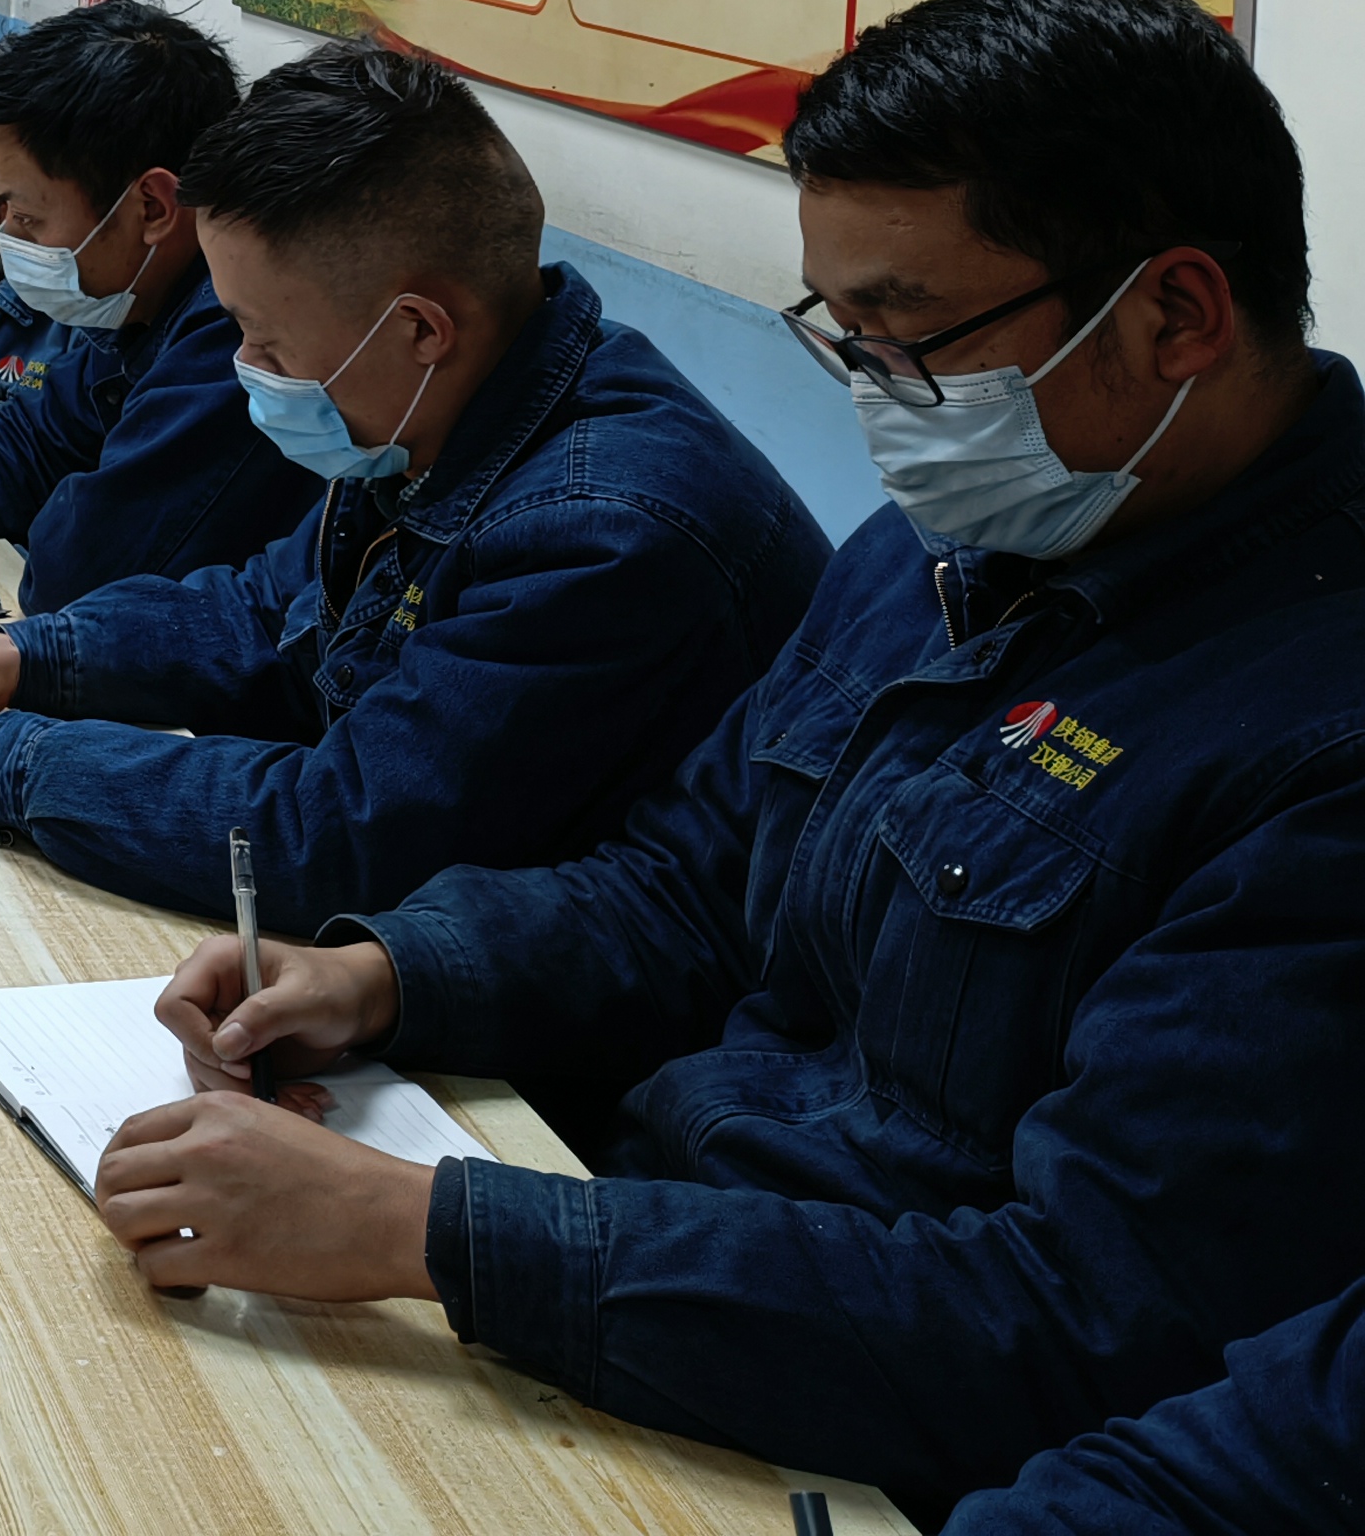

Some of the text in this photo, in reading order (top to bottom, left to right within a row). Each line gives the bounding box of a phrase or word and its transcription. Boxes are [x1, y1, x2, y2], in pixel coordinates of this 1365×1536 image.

[1027, 740, 1098, 792] 汉钢公司
[1050, 715, 1124, 767] 陕钢集团
